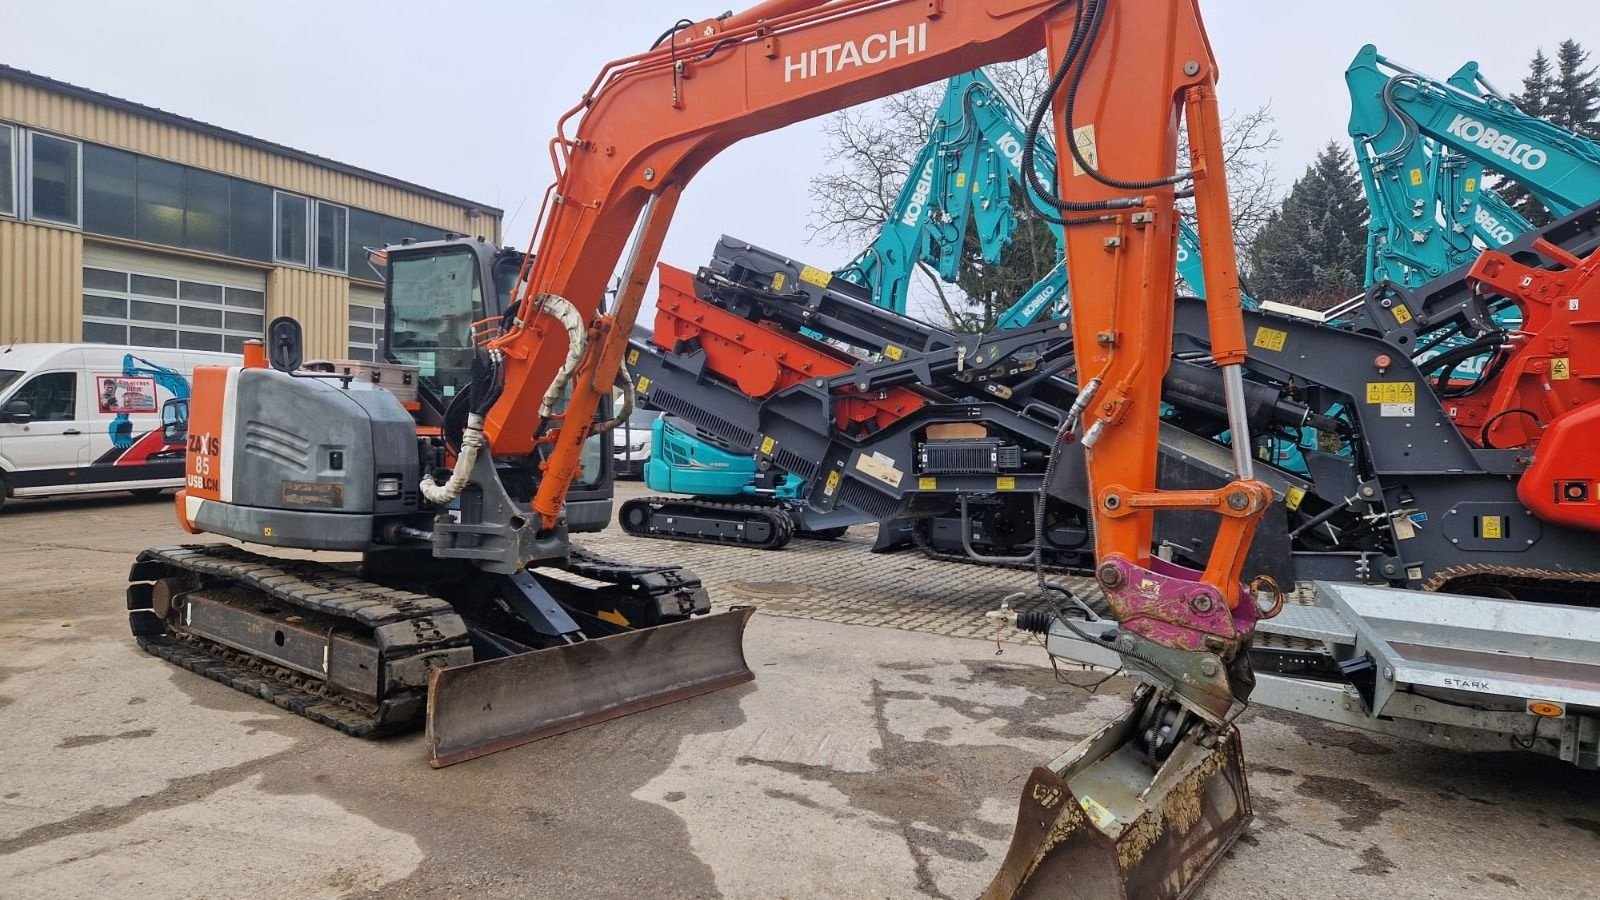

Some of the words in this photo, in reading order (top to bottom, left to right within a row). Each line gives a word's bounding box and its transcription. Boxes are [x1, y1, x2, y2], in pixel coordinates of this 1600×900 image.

[784, 22, 927, 83] HITACHI
[1446, 114, 1547, 170] KOBELCO
[1475, 204, 1514, 246] BELCO
[1022, 285, 1054, 318] KOBELCO
[189, 432, 220, 456] ZAXIS
[195, 455, 210, 475] 85
[1444, 678, 1490, 690] STARK
